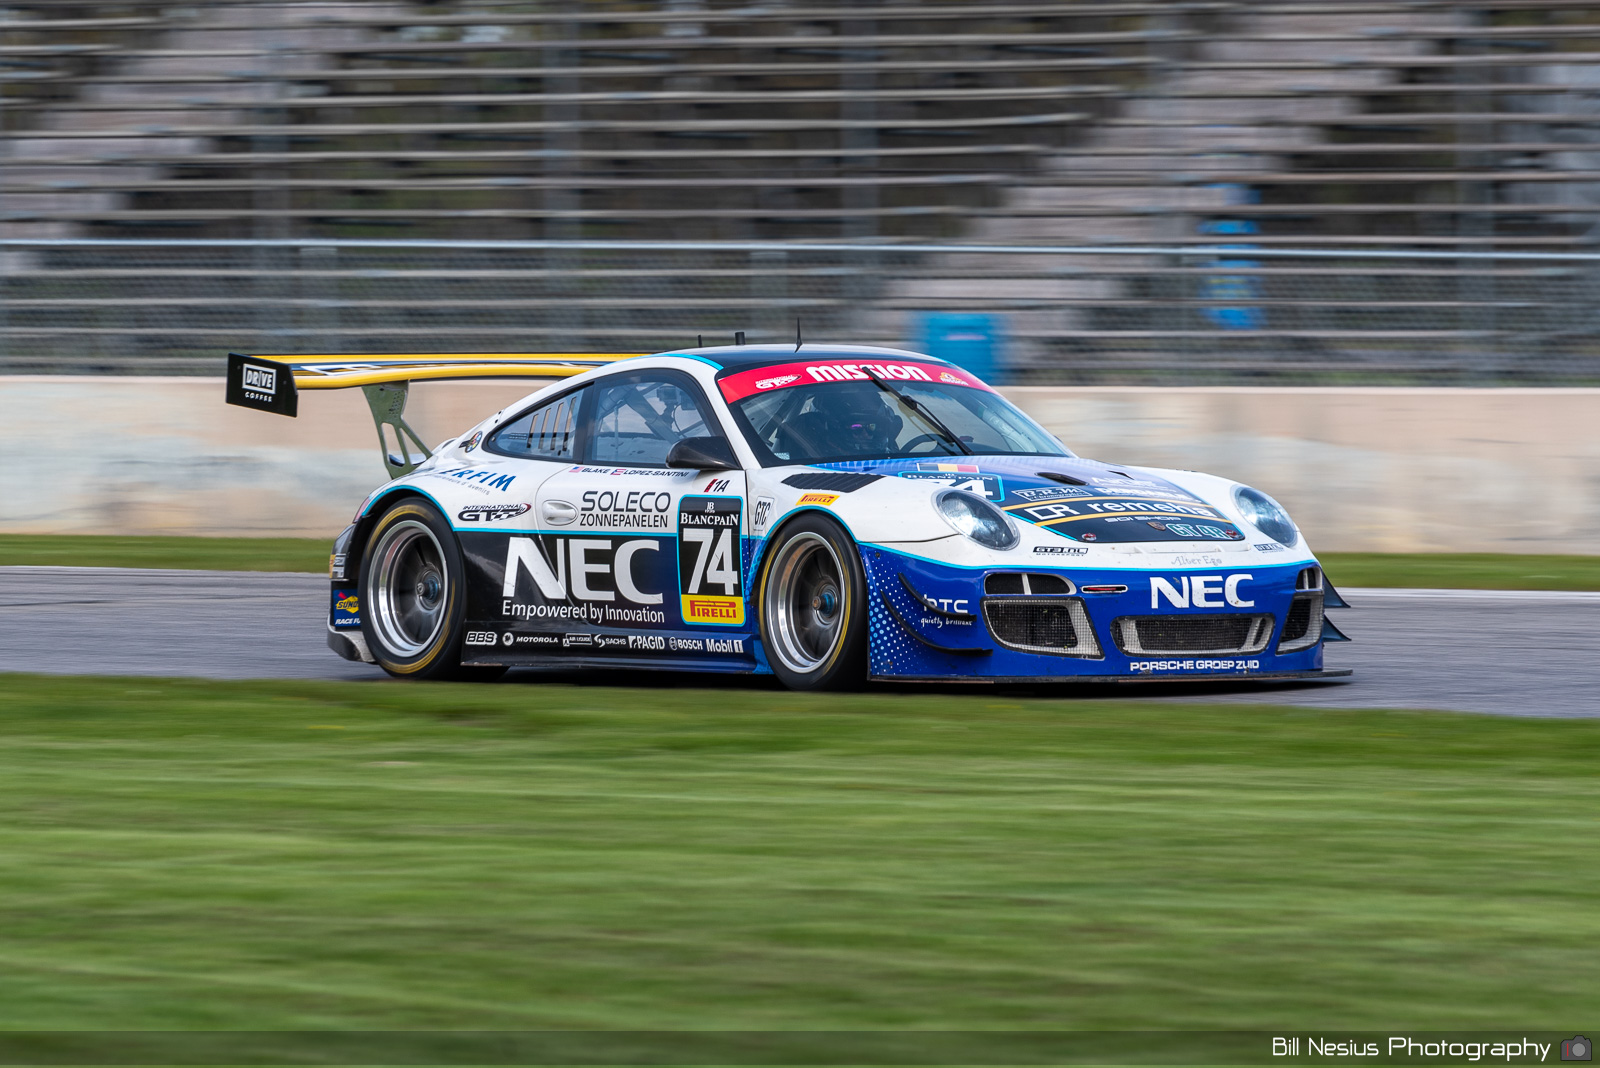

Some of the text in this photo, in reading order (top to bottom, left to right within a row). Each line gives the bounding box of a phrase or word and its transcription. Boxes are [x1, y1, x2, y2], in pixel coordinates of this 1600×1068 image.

[246, 369, 273, 388] DRIVE
[244, 391, 273, 403] COFFEE
[623, 469, 690, 478] LOPEZ-SANTINI
[581, 491, 671, 513] SOLECO
[800, 494, 832, 503] PIRELLI
[463, 503, 521, 511] INTERNATIONAL
[754, 500, 771, 526] GTC
[1087, 502, 1218, 518] remeha
[579, 513, 668, 528] ZONNEPANELEN
[680, 512, 739, 526] BLANCPAIN
[683, 528, 738, 595] 74
[1171, 555, 1202, 566] Alter
[502, 536, 664, 605] NEC
[1149, 574, 1255, 609] NEC
[337, 601, 359, 609] SUNO
[502, 599, 665, 623] Empowered by Innovation
[689, 600, 737, 618] PIRELLI
[920, 616, 943, 629] quietly
[465, 631, 498, 646] BBS
[516, 636, 559, 644] MOTOROLA
[605, 637, 627, 645] SACHS
[636, 635, 666, 650] PAGID
[677, 638, 704, 650] BOSCH
[705, 638, 744, 653] Mobil 1
[1130, 660, 1260, 671] PORSCHE GROEP ZUID
